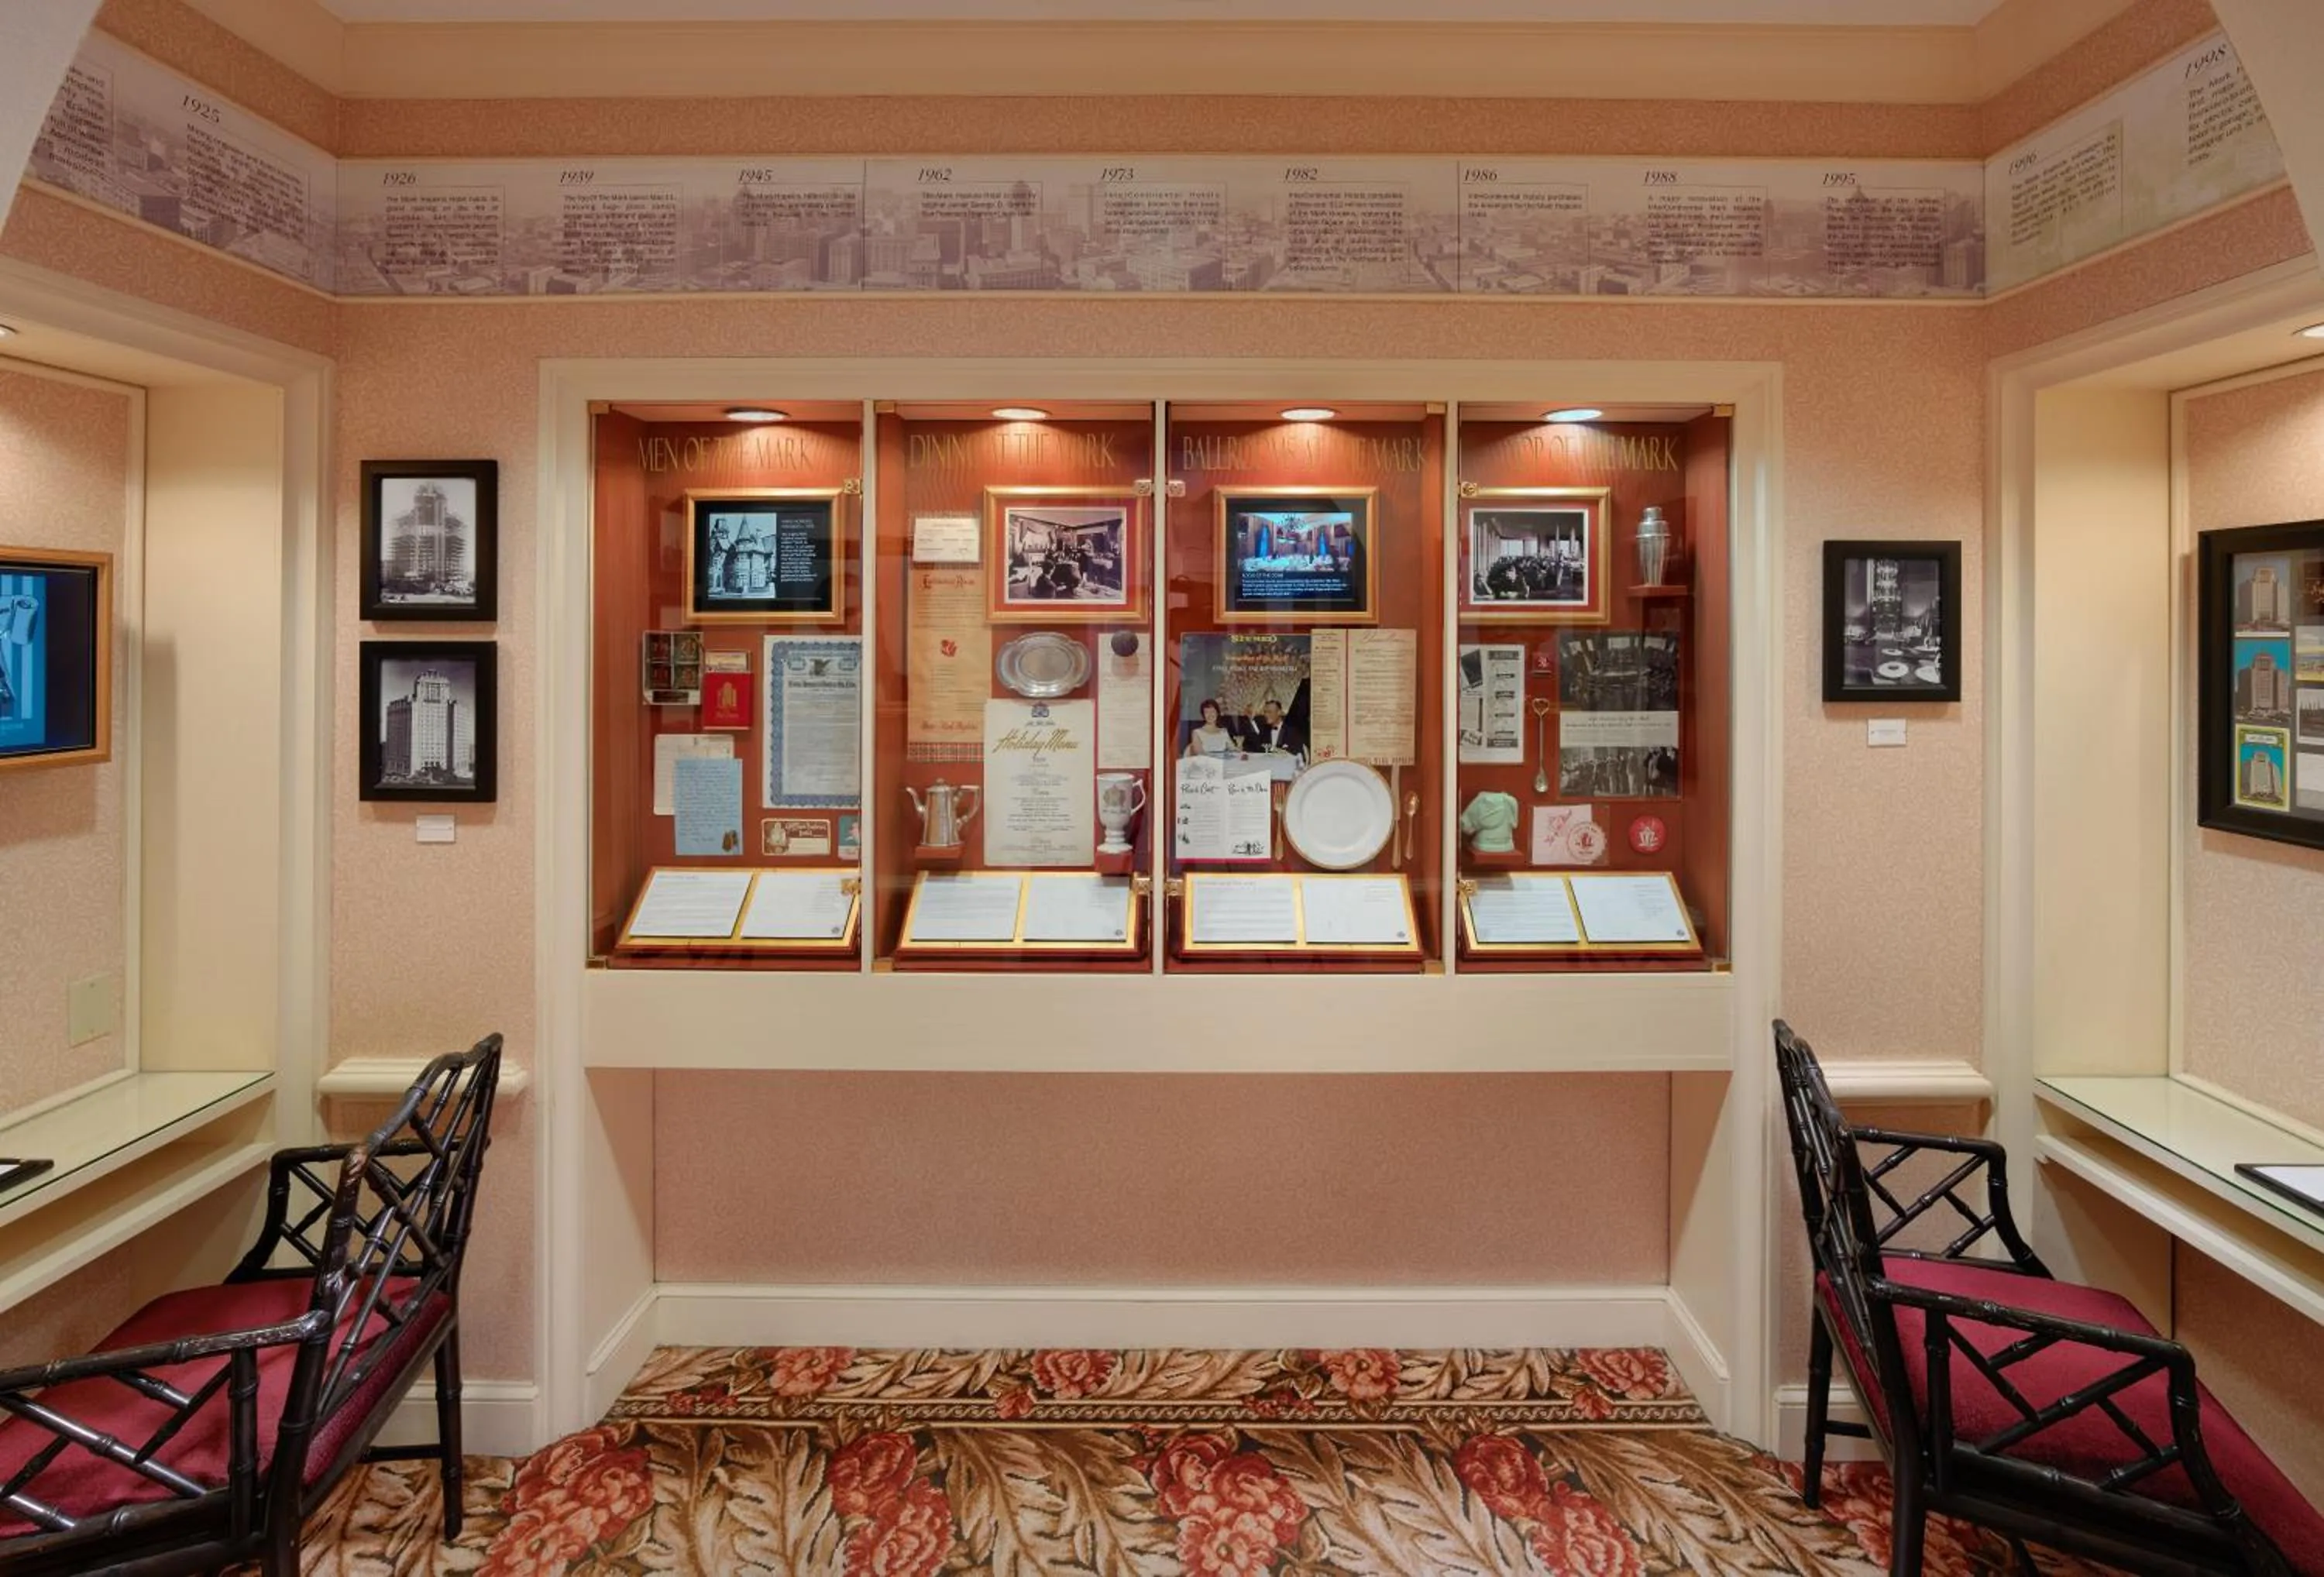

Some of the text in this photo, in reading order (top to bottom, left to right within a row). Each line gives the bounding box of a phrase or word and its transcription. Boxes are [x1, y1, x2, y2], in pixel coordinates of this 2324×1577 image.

[2185, 43, 2228, 79] 1998
[183, 95, 222, 122] 1925
[383, 172, 417, 187] 1926
[559, 170, 594, 185] 1939
[737, 168, 773, 183] 1945
[917, 168, 953, 183] 1962
[1101, 167, 1134, 182] 1973
[1284, 167, 1318, 181] 1982
[1463, 168, 1498, 183] 1986
[1643, 170, 1677, 184] 1988
[1822, 172, 1858, 187] 1995
[638, 436, 679, 472] MEN
[755, 436, 814, 472] MARK
[1013, 433, 1050, 467] THE
[1620, 435, 1679, 472] MARK
[992, 727, 1044, 758] Holiday
